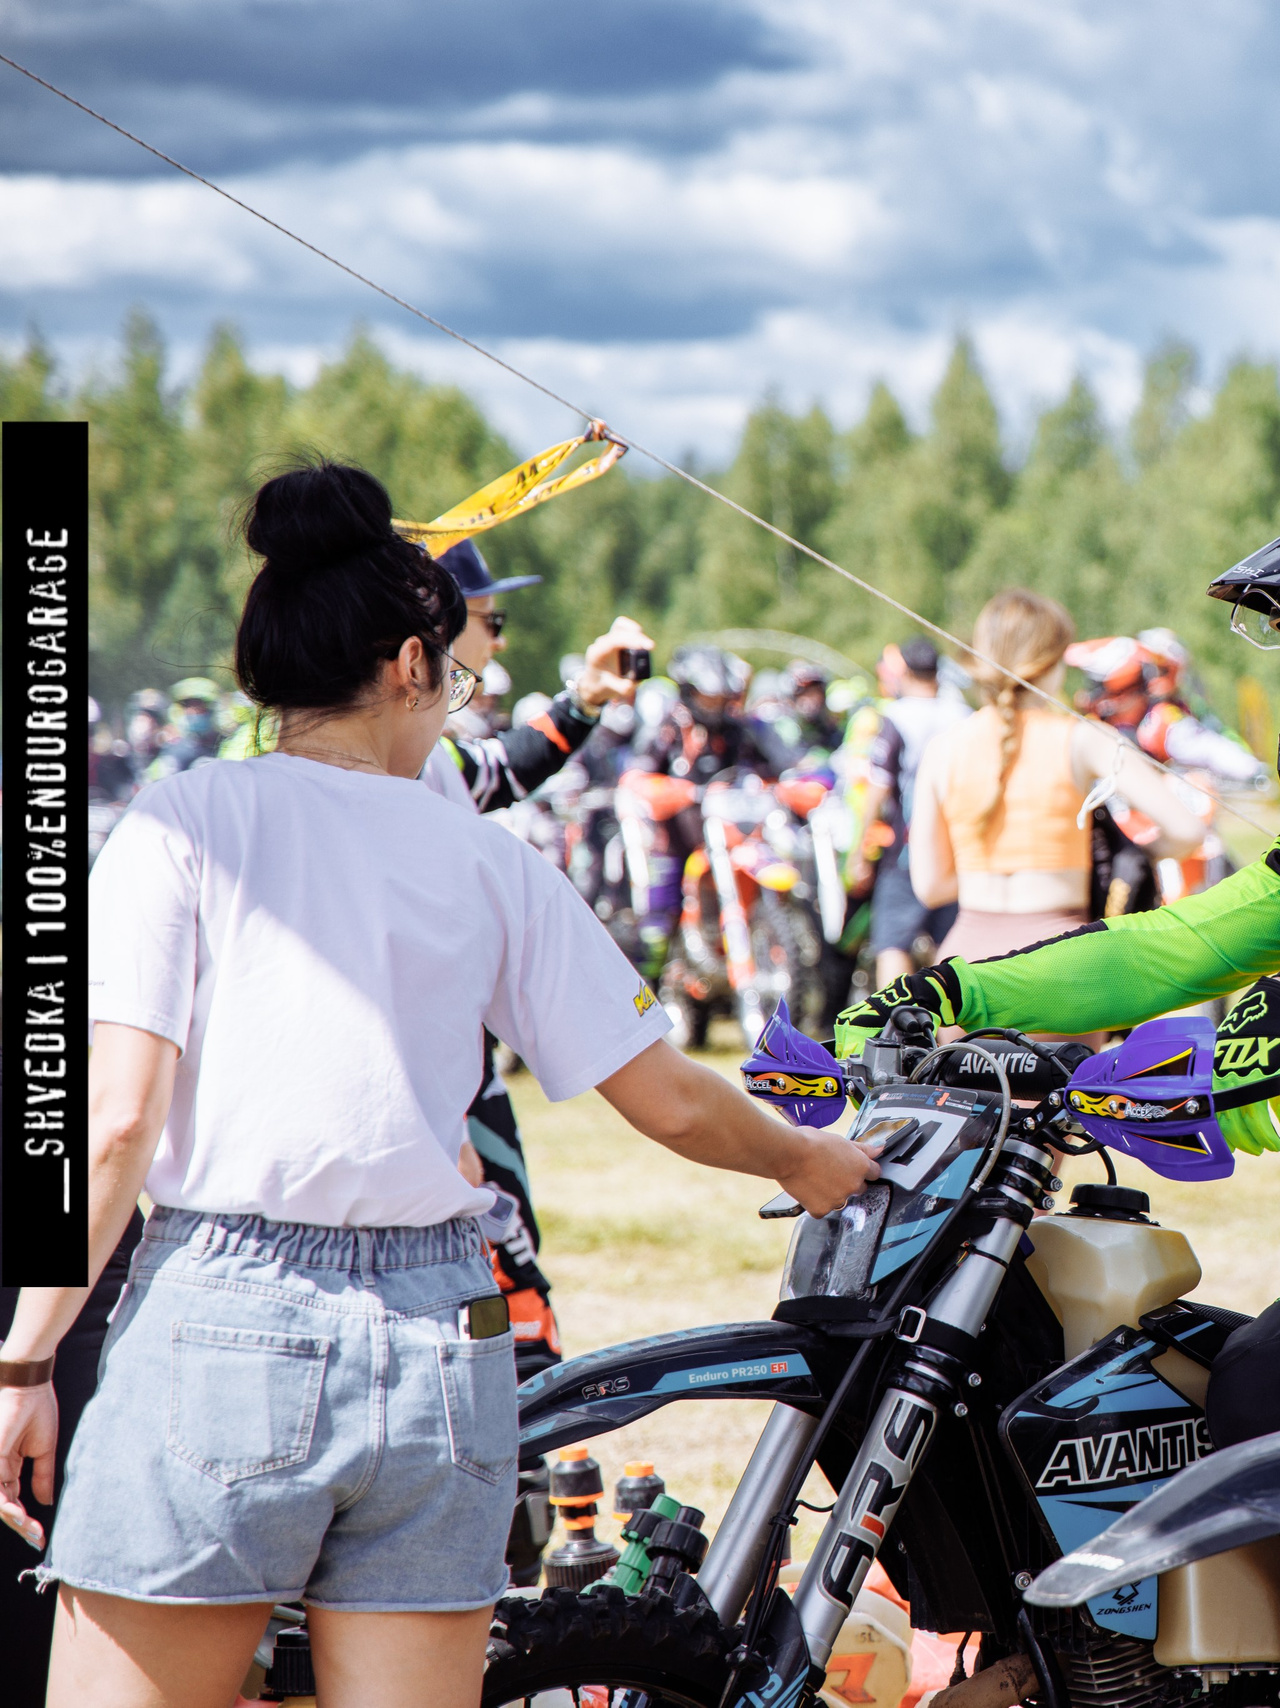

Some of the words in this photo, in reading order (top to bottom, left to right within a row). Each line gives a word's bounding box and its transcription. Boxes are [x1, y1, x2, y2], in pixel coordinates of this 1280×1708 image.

[958, 1052, 1039, 1074] AVANTIS
[688, 1371, 729, 1384] Enduro
[731, 1364, 767, 1378] PR250
[770, 1361, 788, 1374] EFI
[581, 1376, 631, 1400] ARS
[1096, 1602, 1152, 1616] ZONGSHEN
